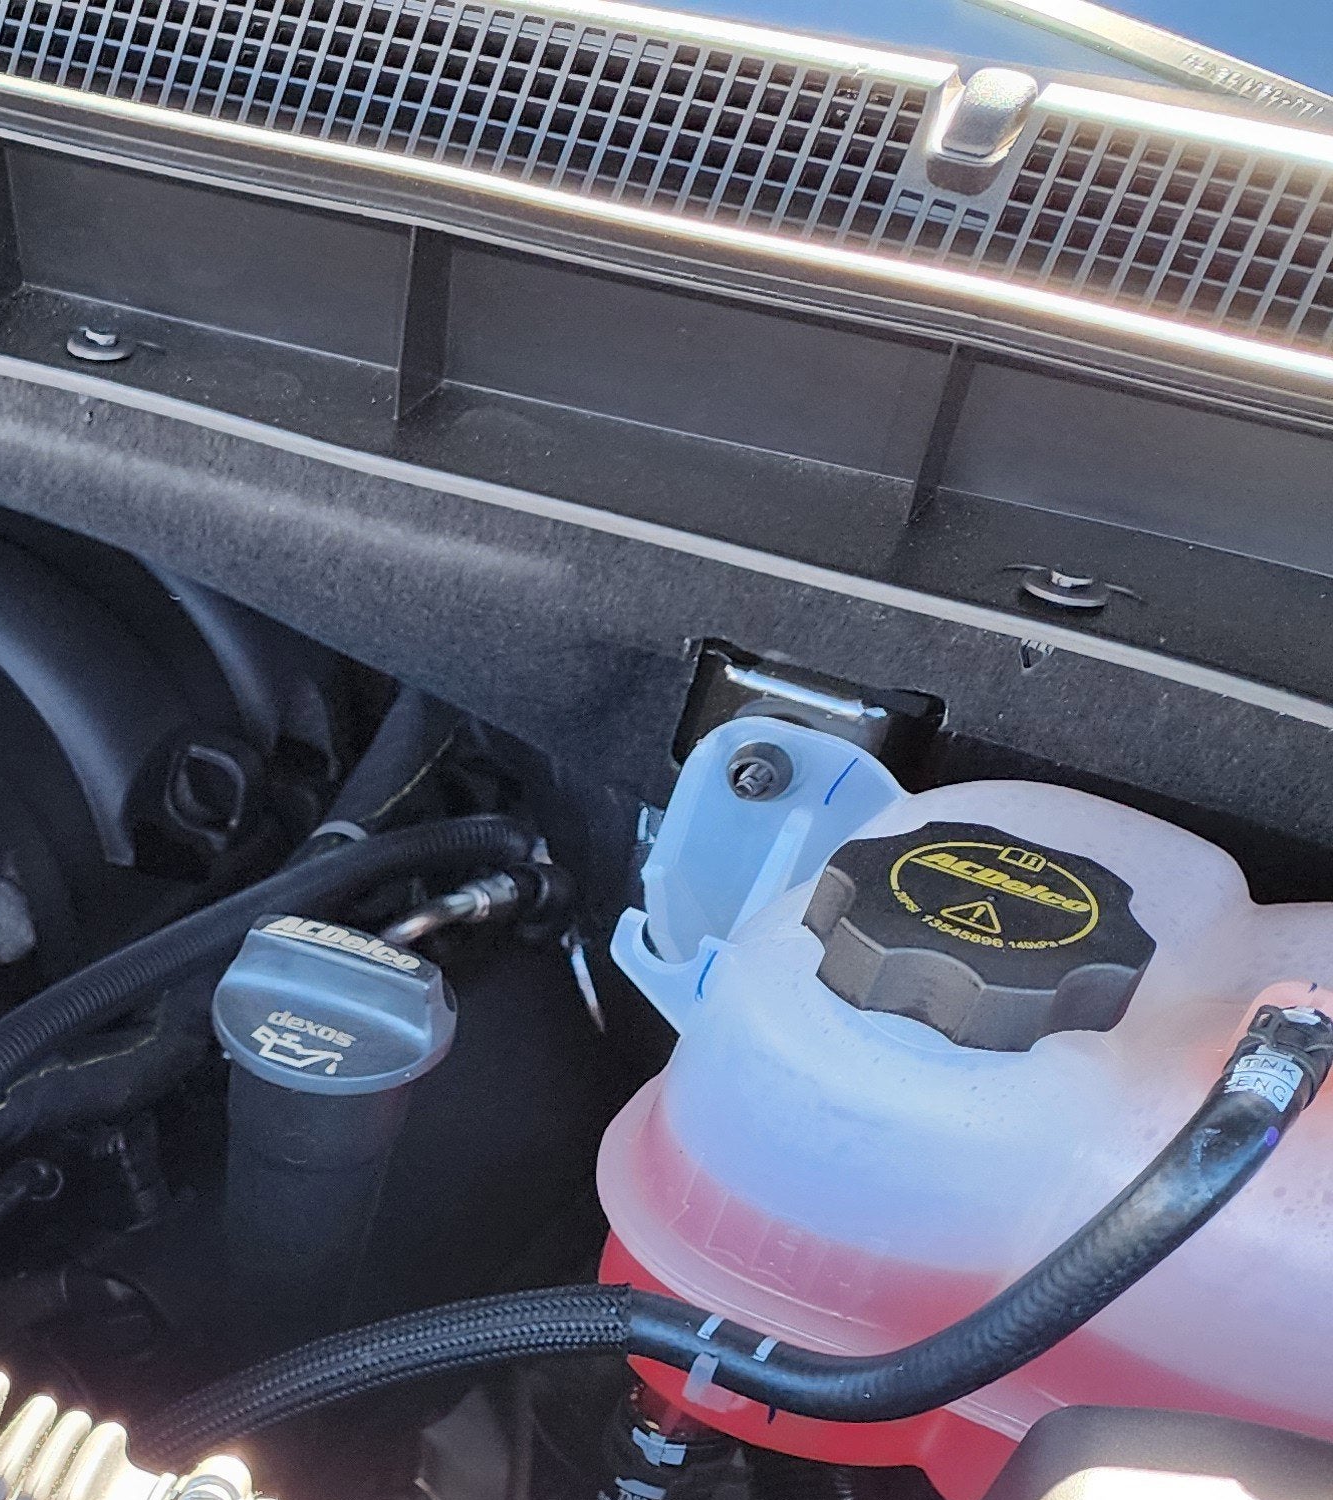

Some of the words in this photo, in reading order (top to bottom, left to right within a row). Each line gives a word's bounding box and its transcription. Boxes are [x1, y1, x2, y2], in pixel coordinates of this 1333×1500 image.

[910, 852, 1091, 912] ACDelco
[260, 915, 421, 975] ACDelco
[267, 1010, 356, 1048] dexos
[1234, 1075, 1287, 1103] ENG
